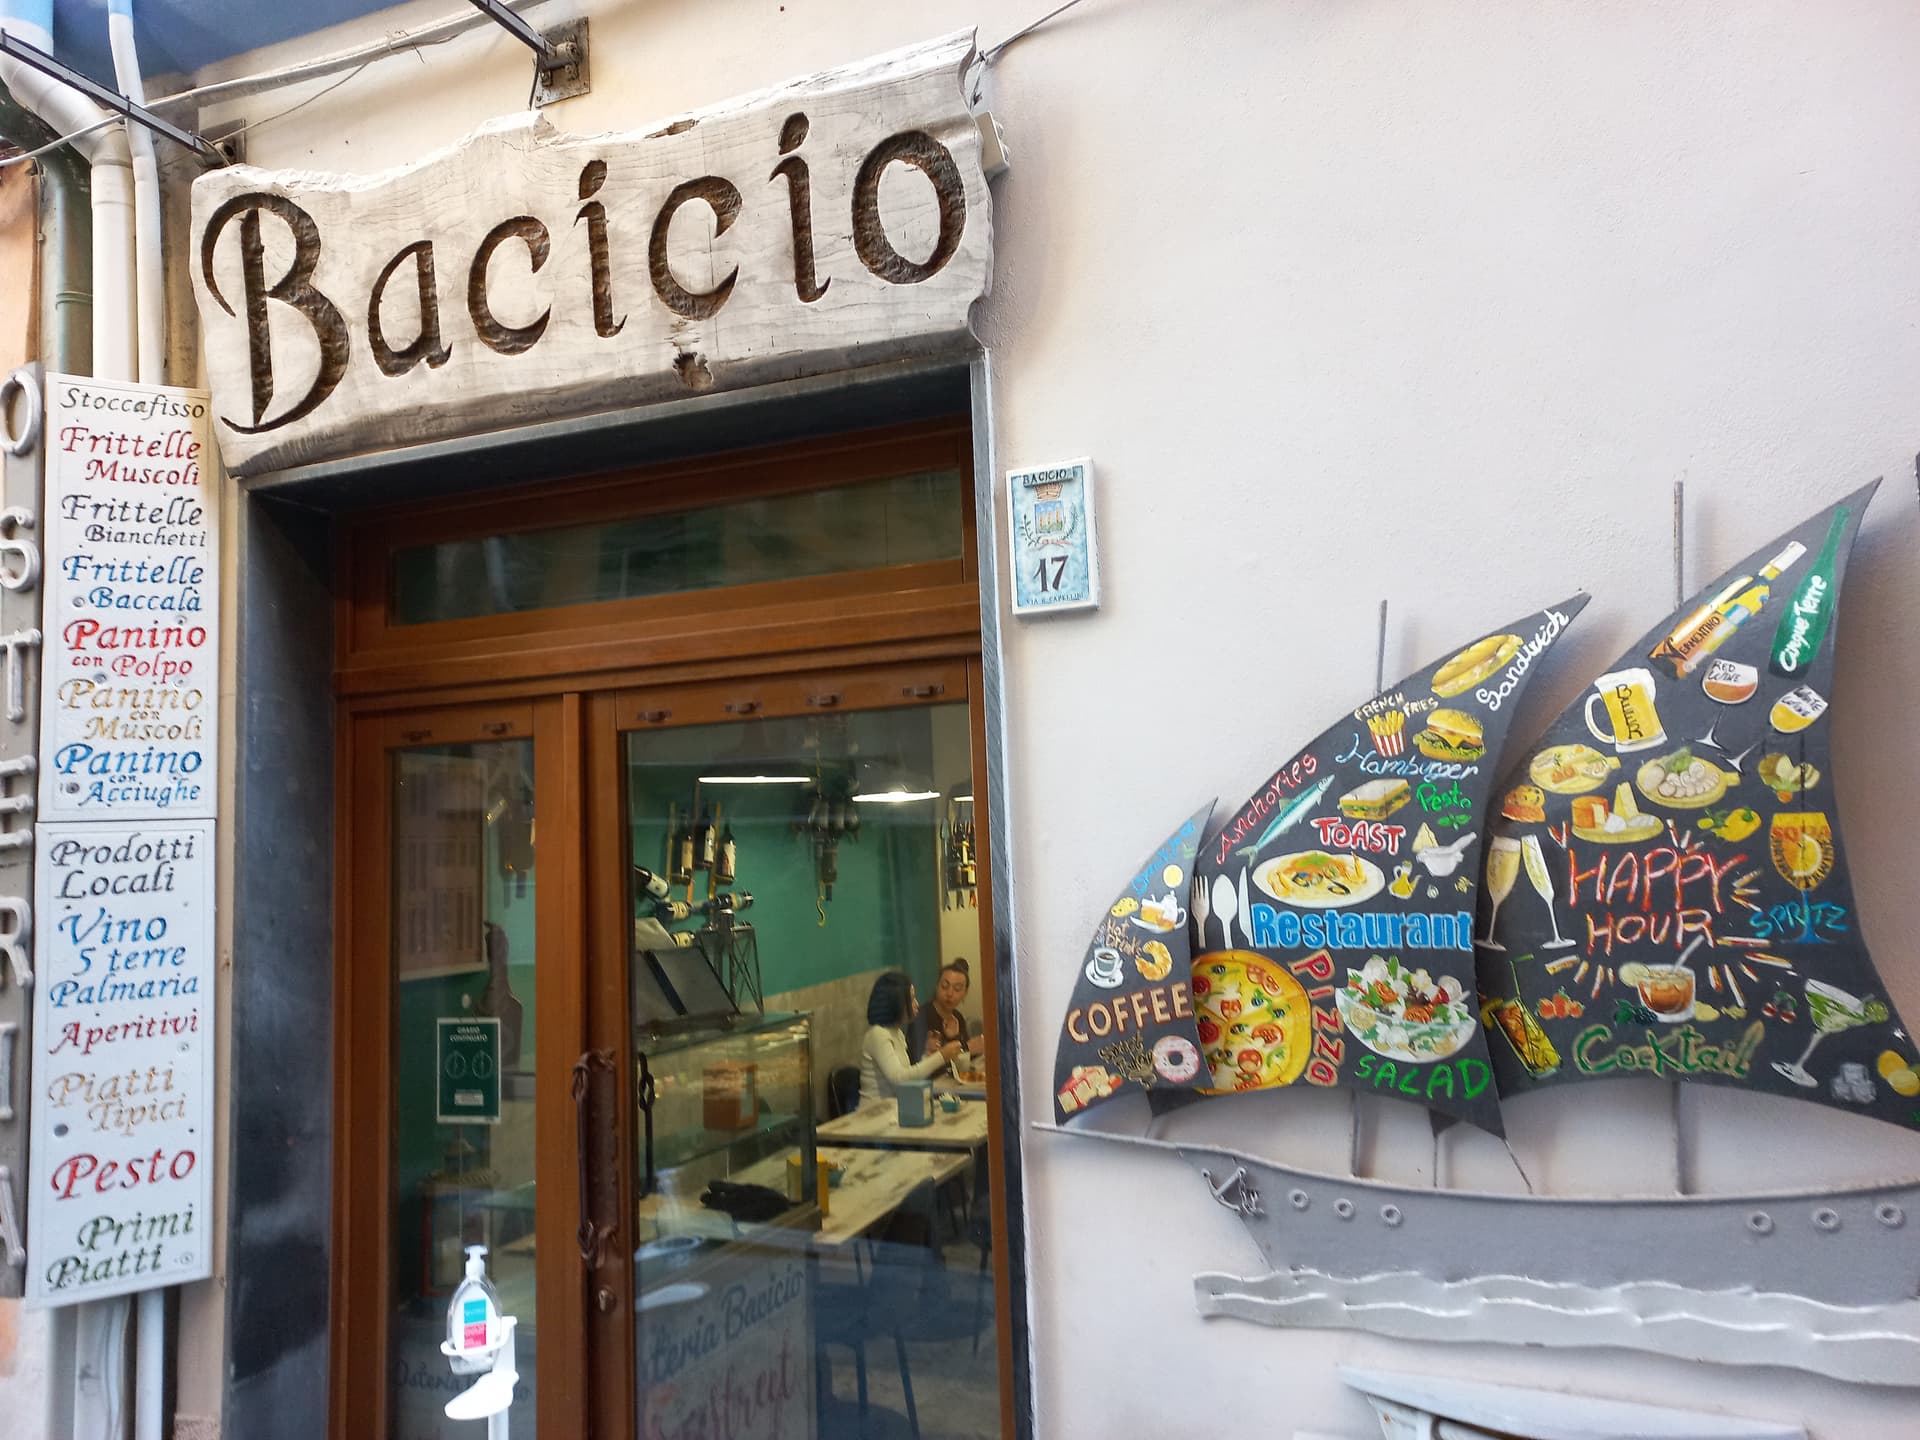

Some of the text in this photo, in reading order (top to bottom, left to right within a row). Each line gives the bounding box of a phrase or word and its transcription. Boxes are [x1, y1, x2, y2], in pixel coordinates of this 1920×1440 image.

[200, 112, 967, 434] Bacicio
[60, 387, 205, 421] Stoccafisso
[60, 426, 201, 460] Frittelle
[85, 458, 200, 486] Muscoli
[61, 494, 203, 526] Frittelle
[85, 523, 206, 547] Bianchetti
[62, 554, 204, 585] Frittelle
[1033, 555, 1070, 593] 17
[63, 618, 207, 651] Panino
[1779, 573, 1828, 672] Cinque Terre
[71, 651, 194, 684] con Polpo
[1476, 608, 1570, 711] Sandwich
[1708, 671, 1741, 682] WINE
[1712, 660, 1736, 673] RED
[57, 678, 203, 711] Panino
[1354, 692, 1405, 721] FRENCH
[1403, 697, 1439, 718] FRIES
[82, 715, 203, 741] Muscoli
[129, 709, 161, 721] con
[54, 743, 202, 776] Panino
[1335, 733, 1479, 782] Hamburger
[78, 777, 201, 808] Acciughe
[1416, 780, 1472, 814] Pesto
[50, 832, 195, 867] Prodotti
[1311, 816, 1406, 855] TOAST
[54, 861, 175, 899] Locali
[1568, 847, 1749, 913] HAPPY
[58, 907, 167, 945] Vino
[1106, 918, 1130, 936] Hot
[1250, 902, 1473, 952] Restaurant
[1586, 909, 1715, 956] HOUR
[1749, 902, 1849, 938] SPRITZ
[72, 946, 187, 977] 5 terre
[50, 972, 199, 1008] Palmaria
[1066, 981, 1194, 1044] COFFEE
[48, 1008, 199, 1055] Aperitivi
[48, 1063, 174, 1108] Piatti
[1354, 1054, 1491, 1100] SALAD
[87, 1092, 187, 1136] Tipici
[50, 1148, 196, 1201] Pesto
[77, 1203, 195, 1251] Primi
[46, 1244, 164, 1292] Piatti
